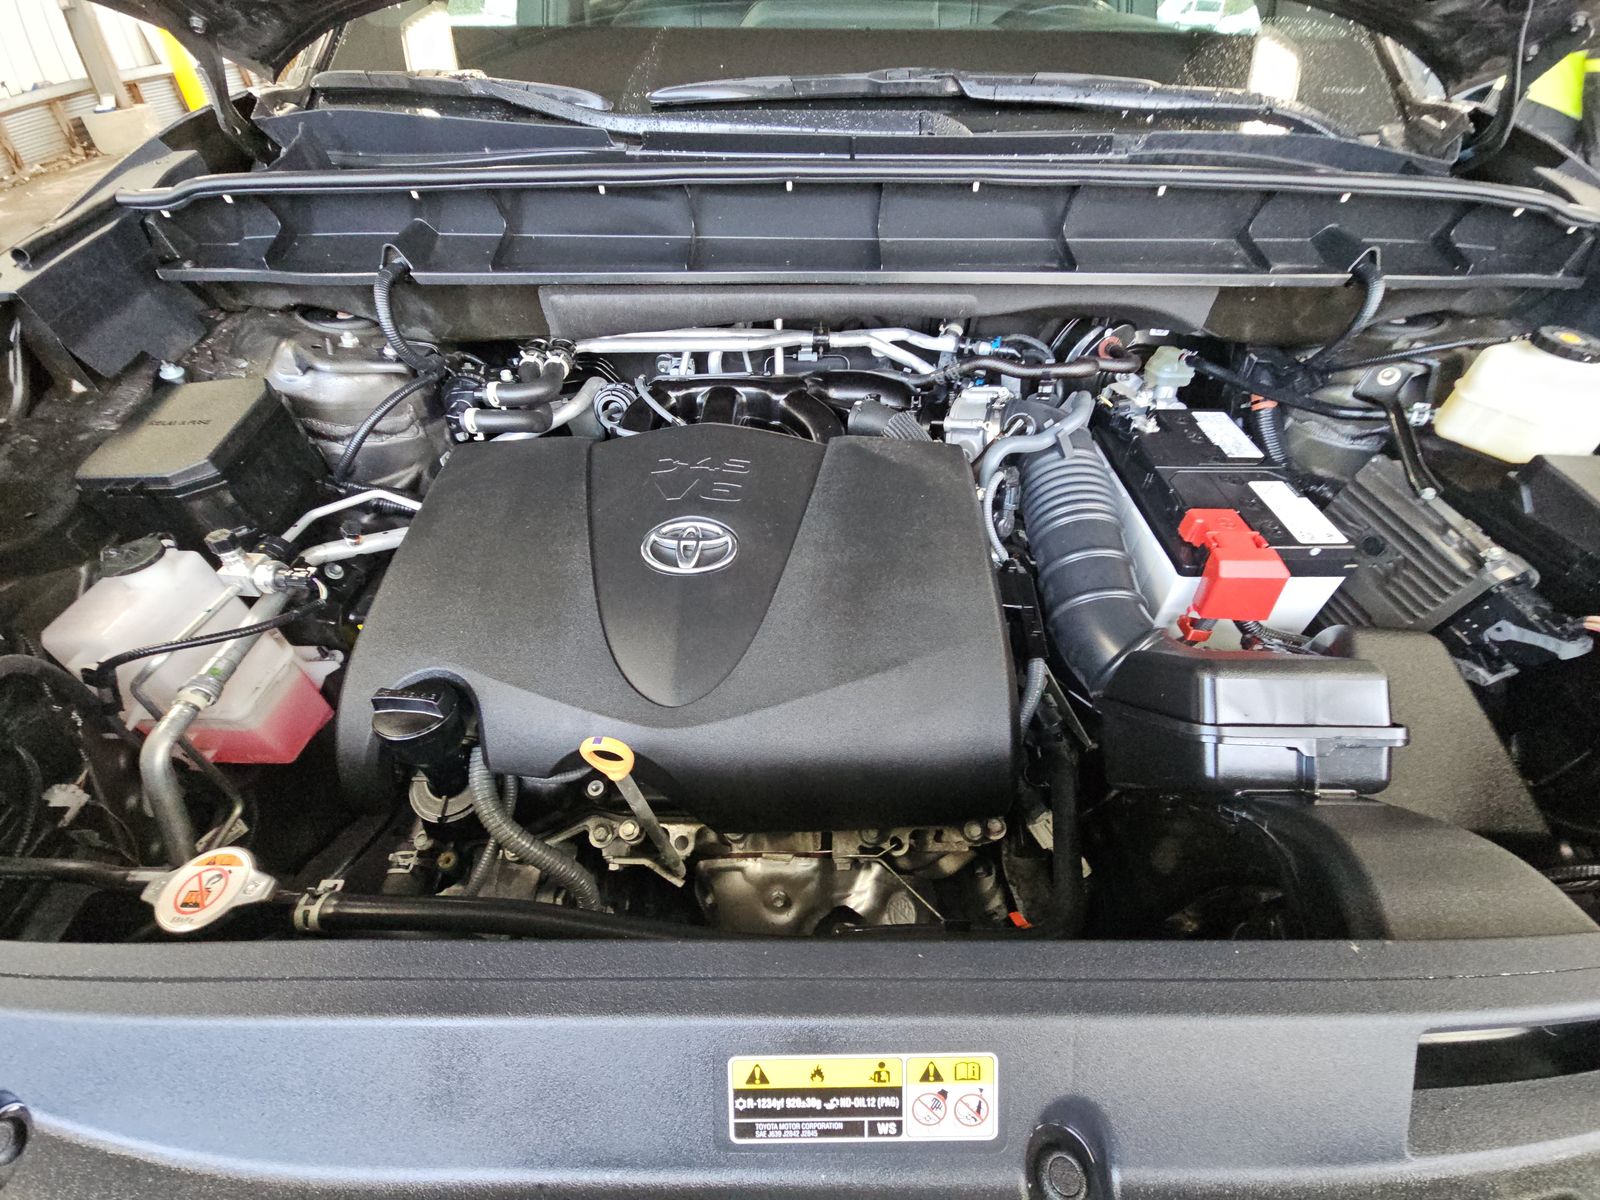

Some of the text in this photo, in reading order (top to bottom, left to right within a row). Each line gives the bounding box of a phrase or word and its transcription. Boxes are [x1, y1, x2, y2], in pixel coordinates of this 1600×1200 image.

[755, 1122, 844, 1130] TOYOTA MOTOR CORPORATION
[876, 1122, 897, 1135] WS
[755, 1130, 767, 1138] SAE
